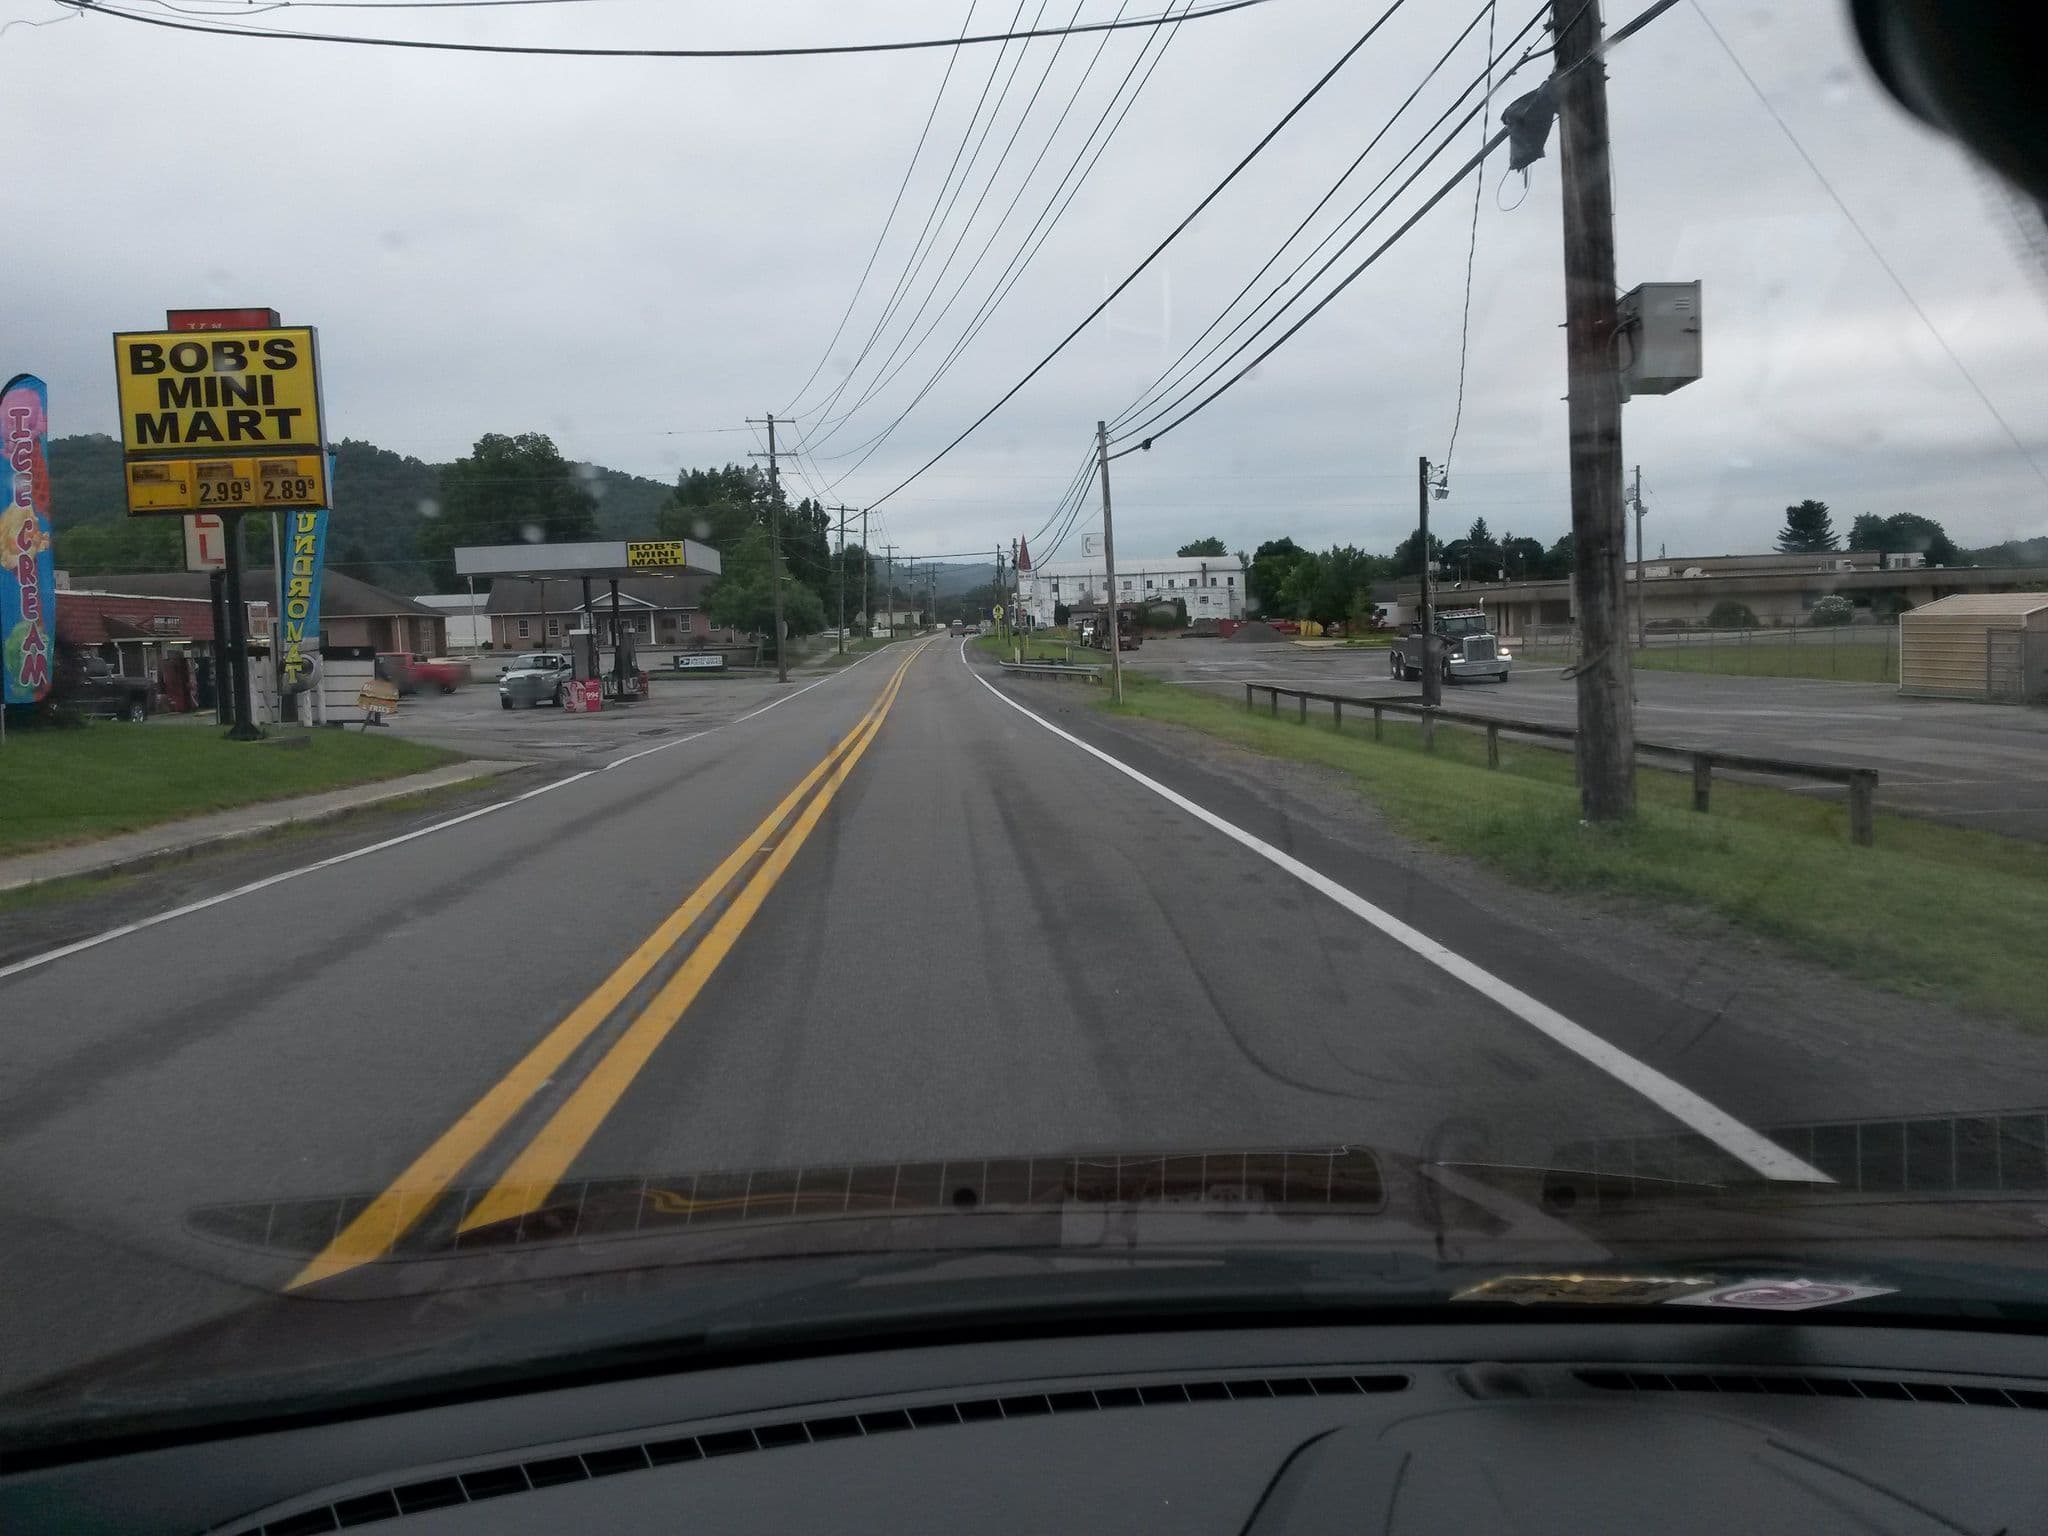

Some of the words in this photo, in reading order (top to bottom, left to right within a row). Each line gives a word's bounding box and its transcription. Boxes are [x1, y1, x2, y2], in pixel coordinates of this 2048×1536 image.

[129, 338, 298, 375] BOB'S
[157, 375, 275, 409] MINI
[135, 408, 302, 445] MART
[9, 406, 34, 508] ICE
[629, 543, 681, 551] BOB'S
[631, 557, 681, 566] MART
[636, 550, 675, 558] MINI
[16, 519, 48, 689] CREAM
